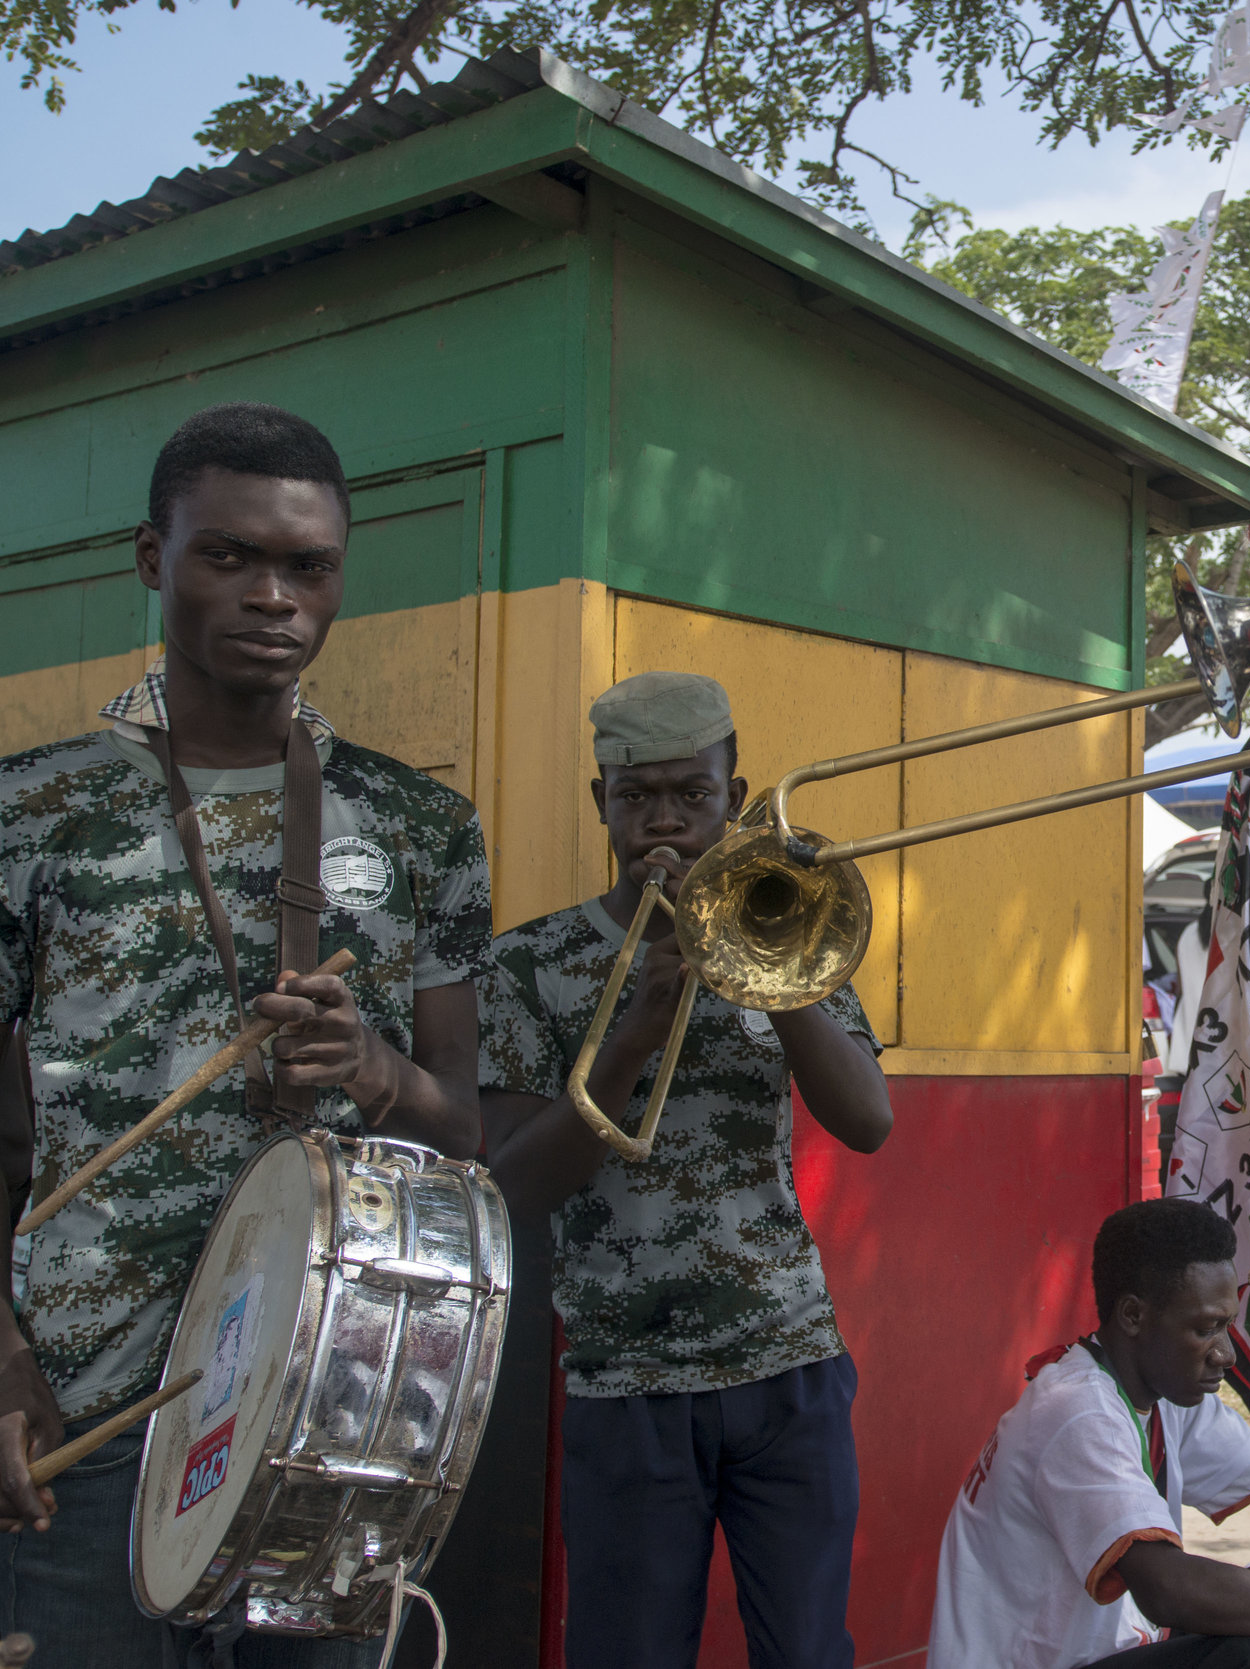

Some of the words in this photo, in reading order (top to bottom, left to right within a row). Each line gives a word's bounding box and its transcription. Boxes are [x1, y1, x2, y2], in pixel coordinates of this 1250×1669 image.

[320, 837, 354, 858] BRIGHT
[356, 838, 390, 868] ANGELS
[325, 890, 360, 905] RASS
[362, 893, 387, 906] BAND
[181, 1444, 229, 1510] CPIC
